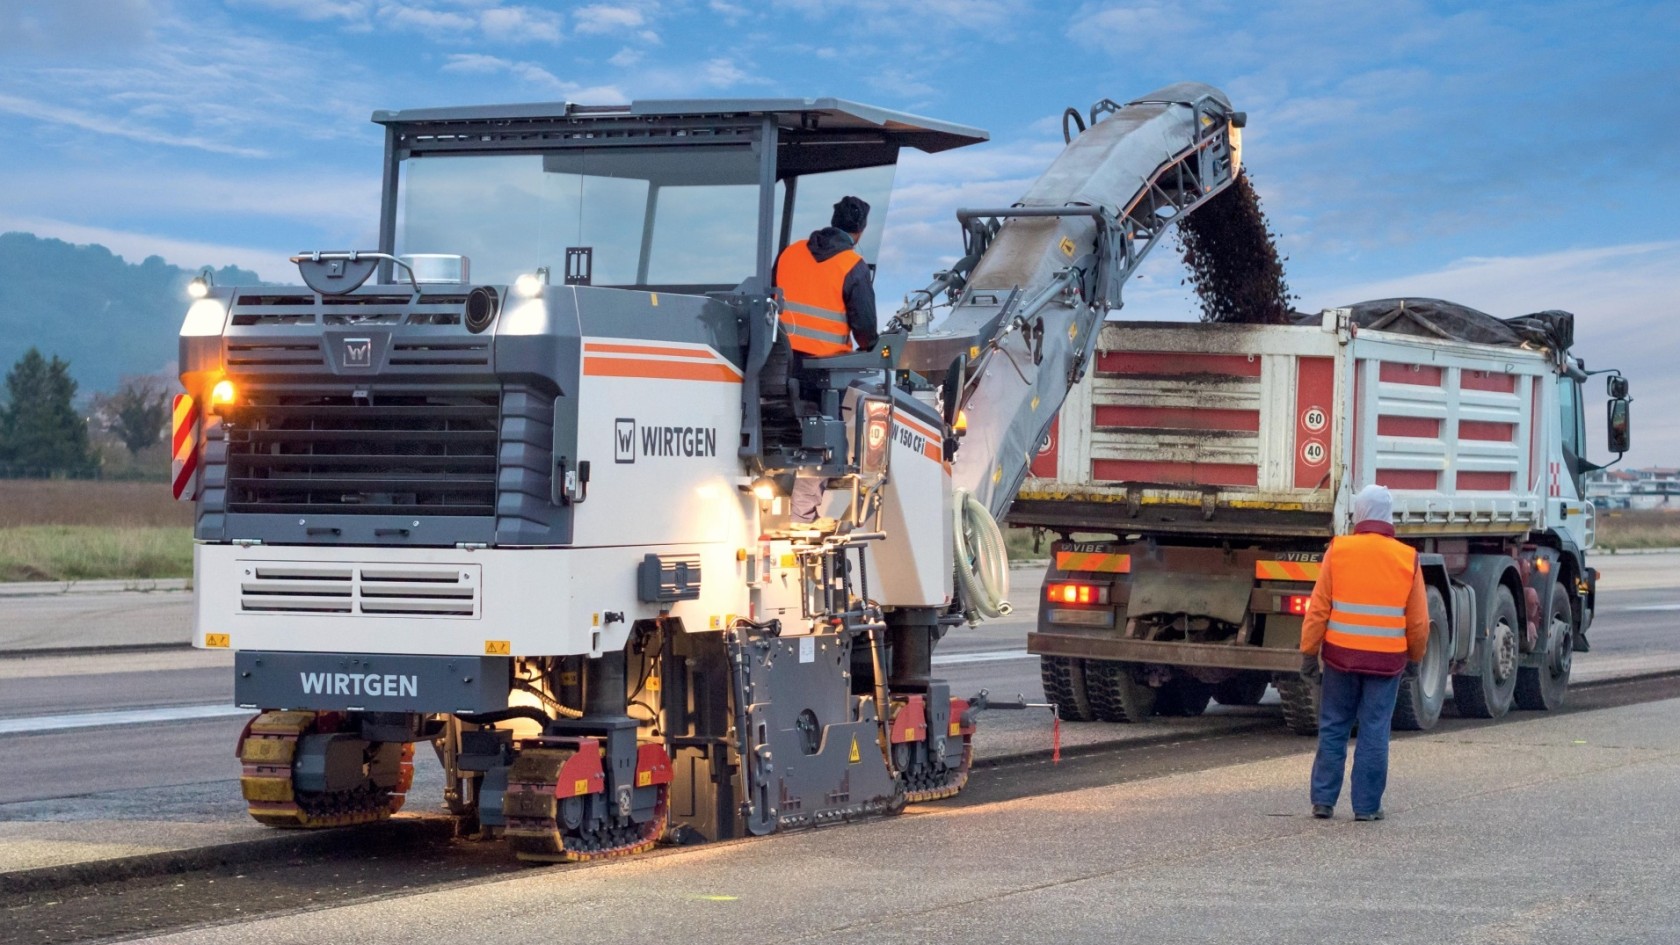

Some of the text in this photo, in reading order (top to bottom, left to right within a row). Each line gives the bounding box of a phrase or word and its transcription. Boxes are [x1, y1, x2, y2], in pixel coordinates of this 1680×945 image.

[1309, 413, 1322, 424] 60
[641, 426, 716, 457] WIRTGEN
[900, 428, 912, 448] 150
[913, 435, 925, 455] CFi
[1308, 445, 1321, 457] 40
[300, 672, 418, 697] WIRTGEN
